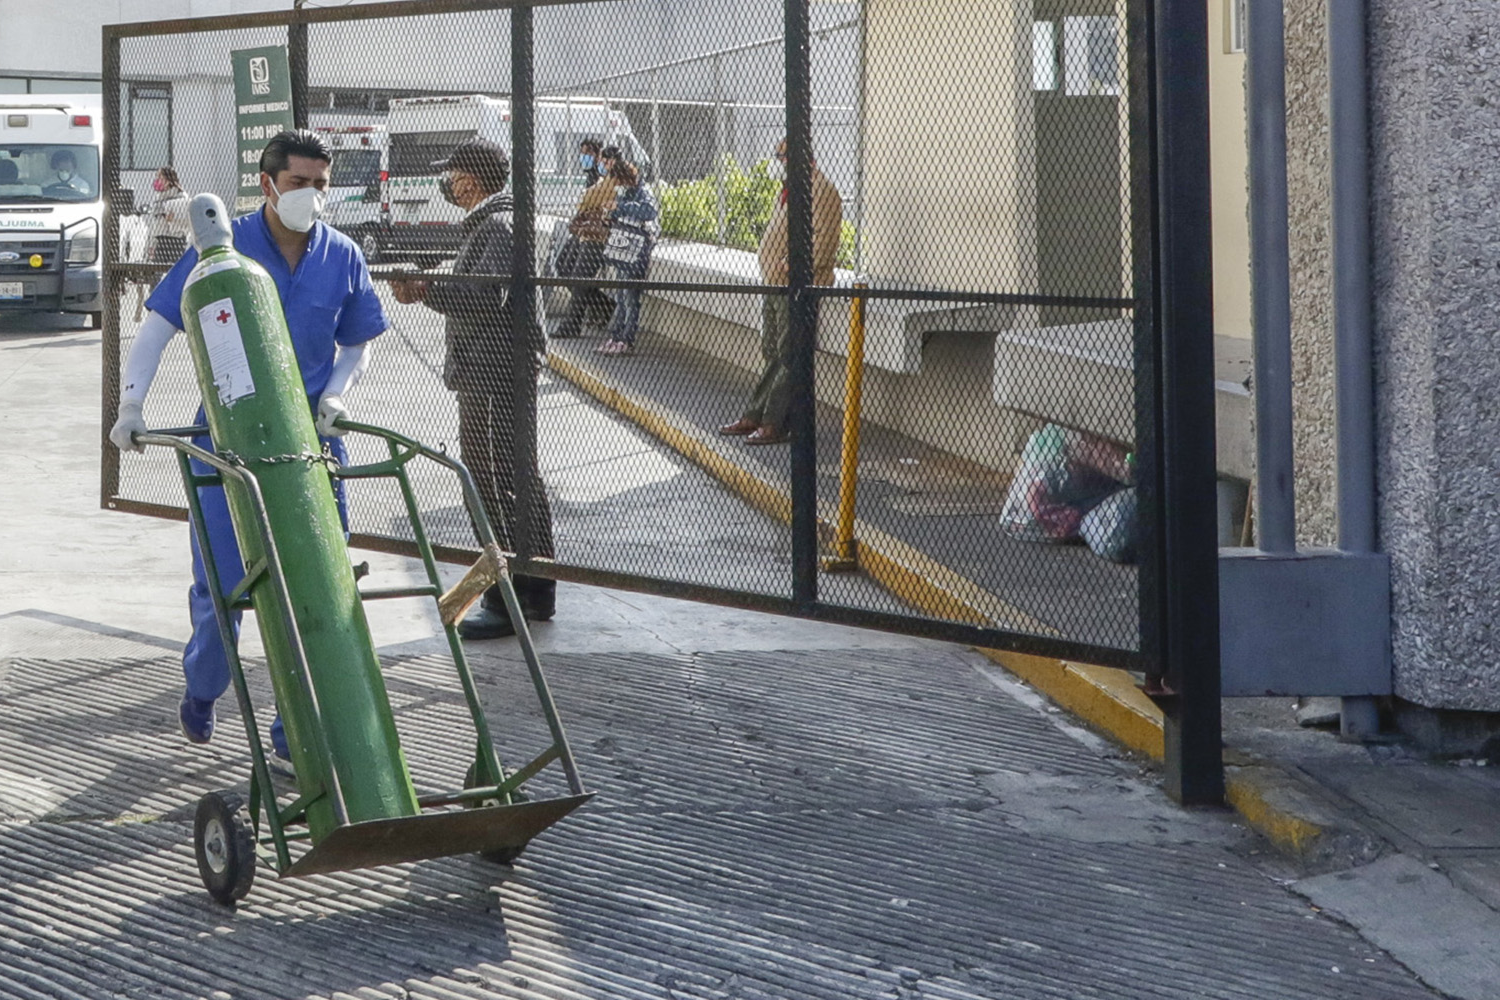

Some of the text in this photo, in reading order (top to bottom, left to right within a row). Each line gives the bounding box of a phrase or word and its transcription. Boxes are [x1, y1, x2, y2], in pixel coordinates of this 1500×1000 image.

[252, 83, 271, 95] IMSS
[238, 103, 266, 115] INFORME
[241, 125, 264, 141] 11:00
